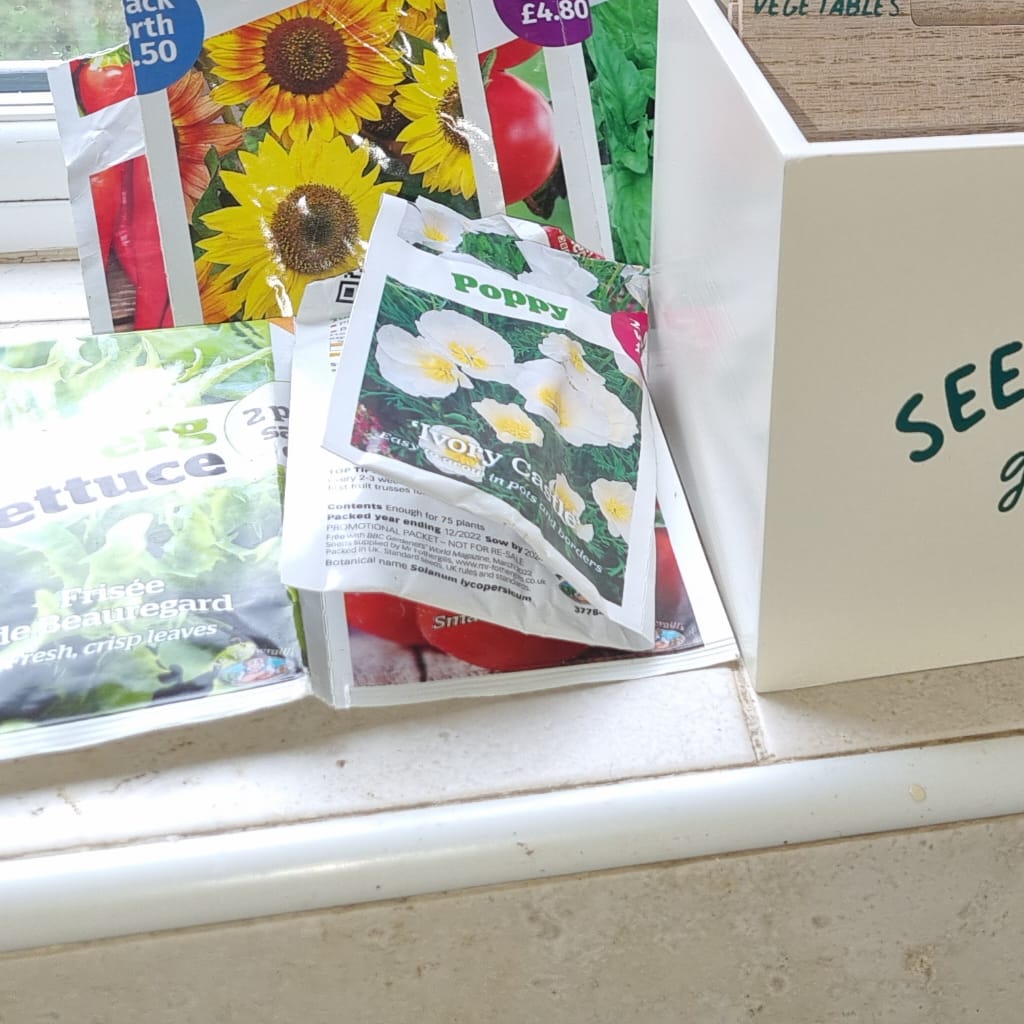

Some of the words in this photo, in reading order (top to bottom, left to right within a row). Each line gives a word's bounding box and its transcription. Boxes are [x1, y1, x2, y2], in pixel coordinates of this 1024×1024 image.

[127, 13, 175, 39] rth
[521, 0, 589, 24] £4.80
[451, 272, 569, 321] Poppy
[102, 418, 217, 457] erg
[0, 452, 227, 529] ettuce
[380, 432, 419, 451] Easy
[559, 528, 603, 573] borders
[327, 512, 371, 520] Packed
[375, 514, 400, 523] year
[403, 519, 441, 534] ending
[445, 528, 481, 541] 12/2022
[485, 536, 509, 546] Sow
[512, 542, 523, 553] by
[524, 548, 543, 561] 202
[386, 504, 422, 517] Enough
[425, 512, 438, 520] for
[441, 516, 453, 524] 75
[456, 518, 485, 531] plants
[326, 523, 401, 535] PROMOTIONAL
[403, 529, 439, 543] PACKET
[448, 540, 467, 549] NOT
[470, 543, 489, 553] FOR
[491, 547, 524, 566] RE-SALE
[429, 546, 451, 556] World
[325, 557, 375, 566] Botanical
[379, 559, 407, 570] name
[410, 564, 457, 583] Solanum
[461, 578, 532, 602] lycopersicum
[40, 594, 234, 634] Beauregard
[574, 606, 605, 616] 3778
[12, 644, 78, 666] resh,
[83, 631, 142, 656] crisp
[148, 624, 217, 644] leaves
